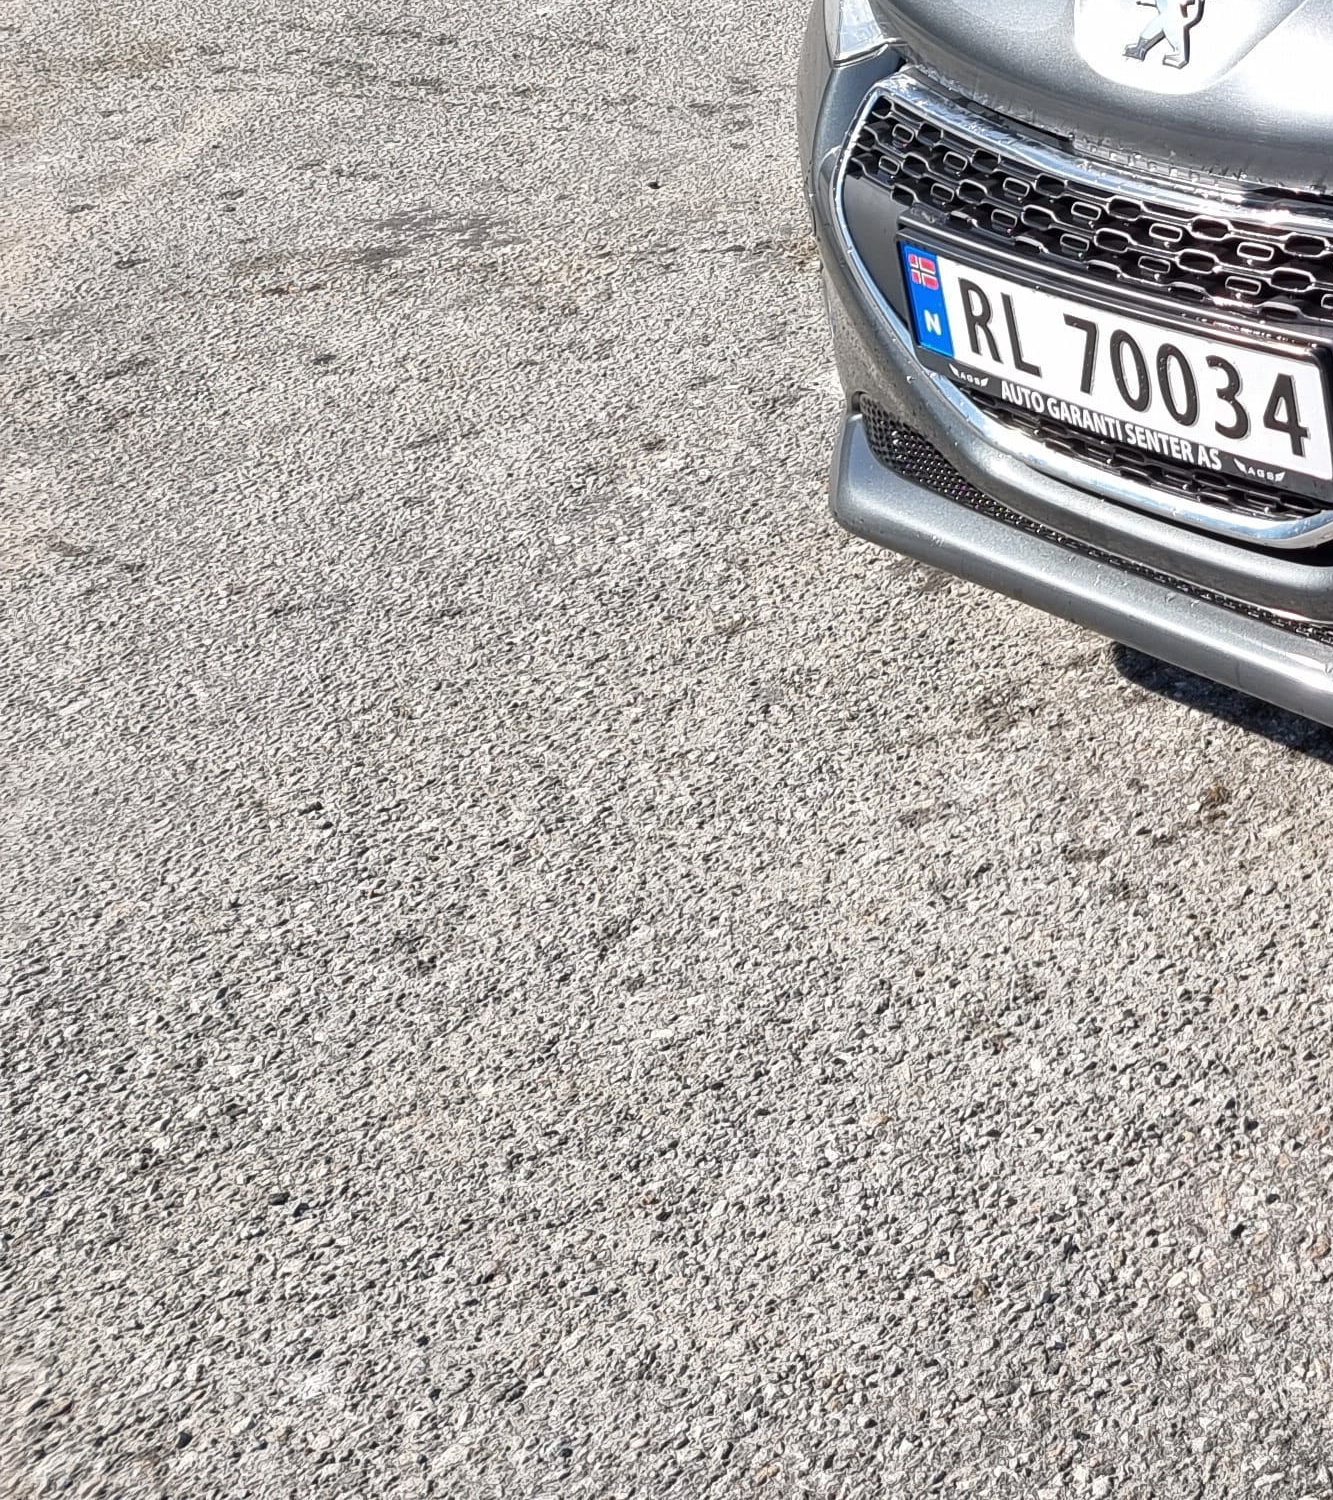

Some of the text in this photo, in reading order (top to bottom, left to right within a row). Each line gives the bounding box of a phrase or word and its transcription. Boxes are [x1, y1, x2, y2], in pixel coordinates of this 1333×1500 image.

[924, 309, 942, 336] N
[957, 276, 1312, 458] RL 70034
[1001, 380, 1223, 471] AUTO GARANTI SENTER AS
